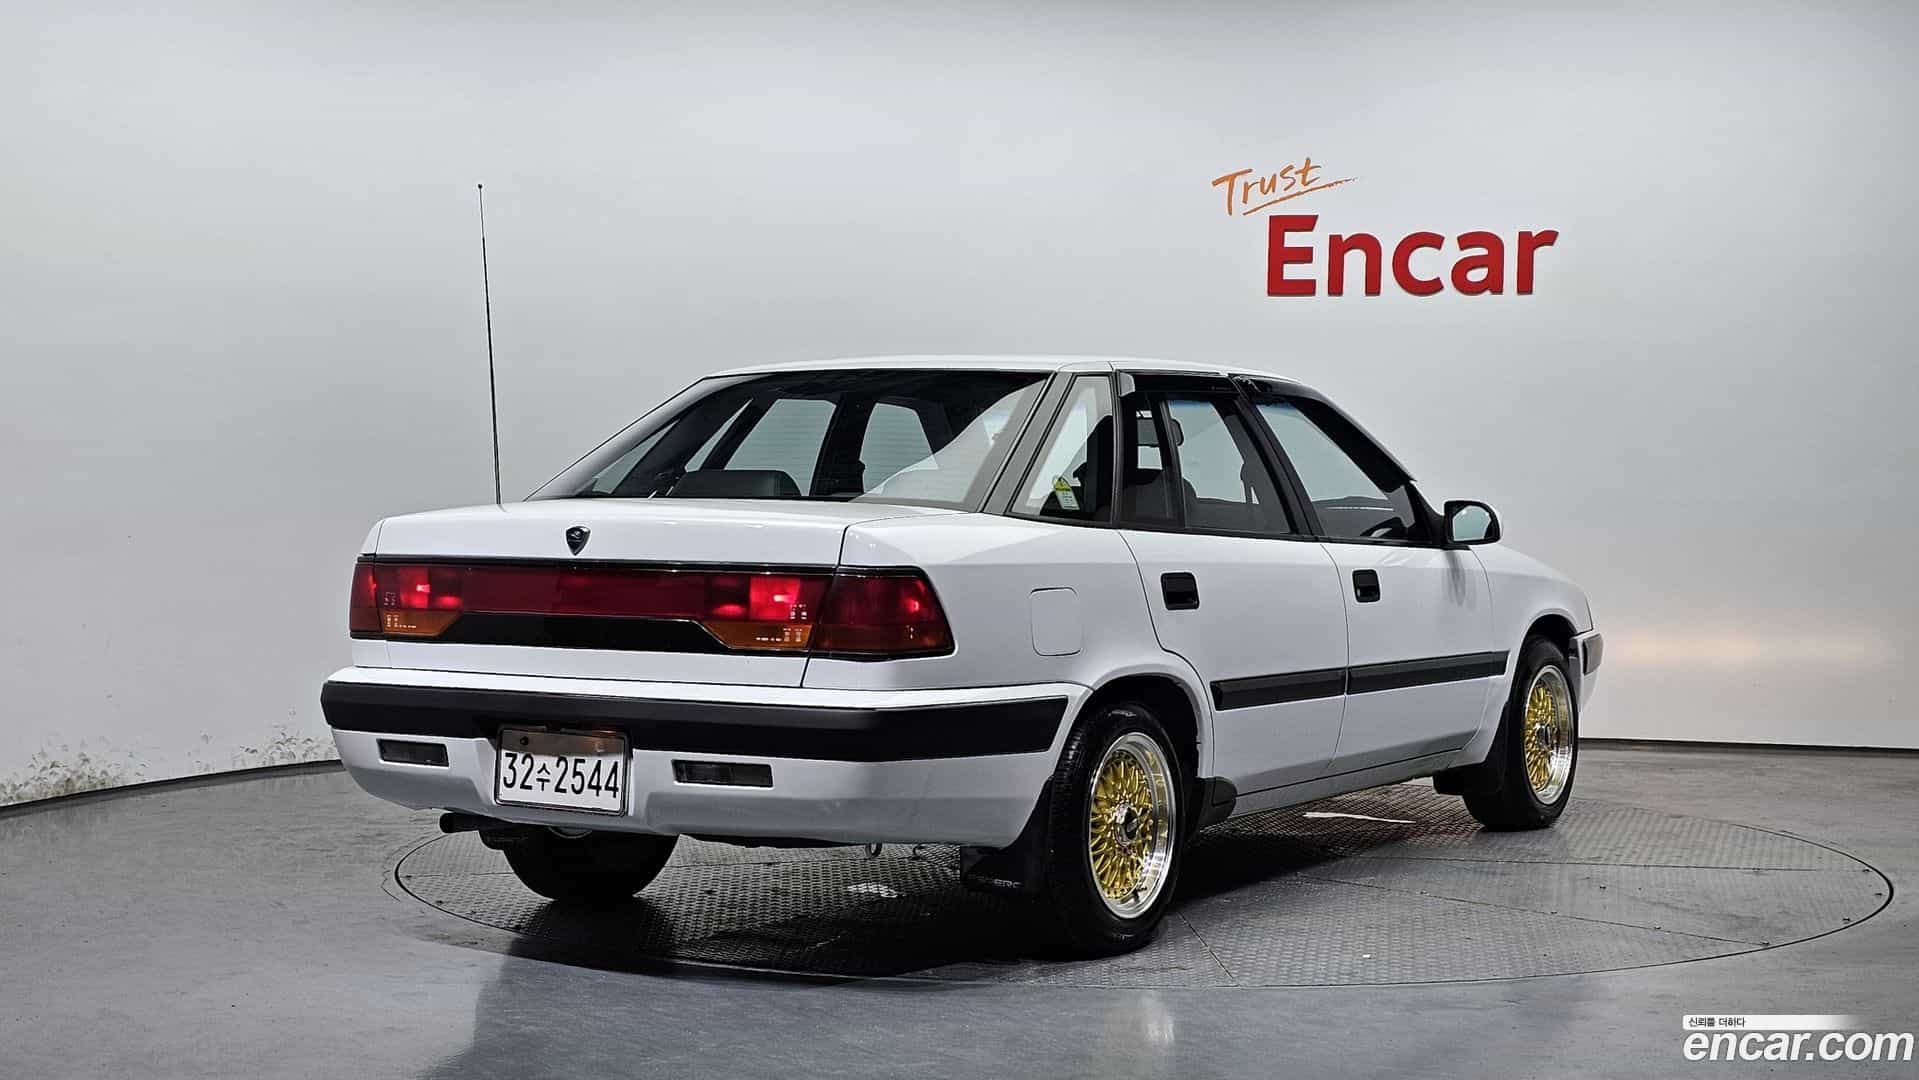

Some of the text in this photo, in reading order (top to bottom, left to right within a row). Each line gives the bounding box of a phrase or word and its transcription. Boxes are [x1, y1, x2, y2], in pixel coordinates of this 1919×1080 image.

[1211, 157, 1322, 216] Trust
[1266, 213, 1560, 297] Encar
[503, 752, 619, 798] 32수2544
